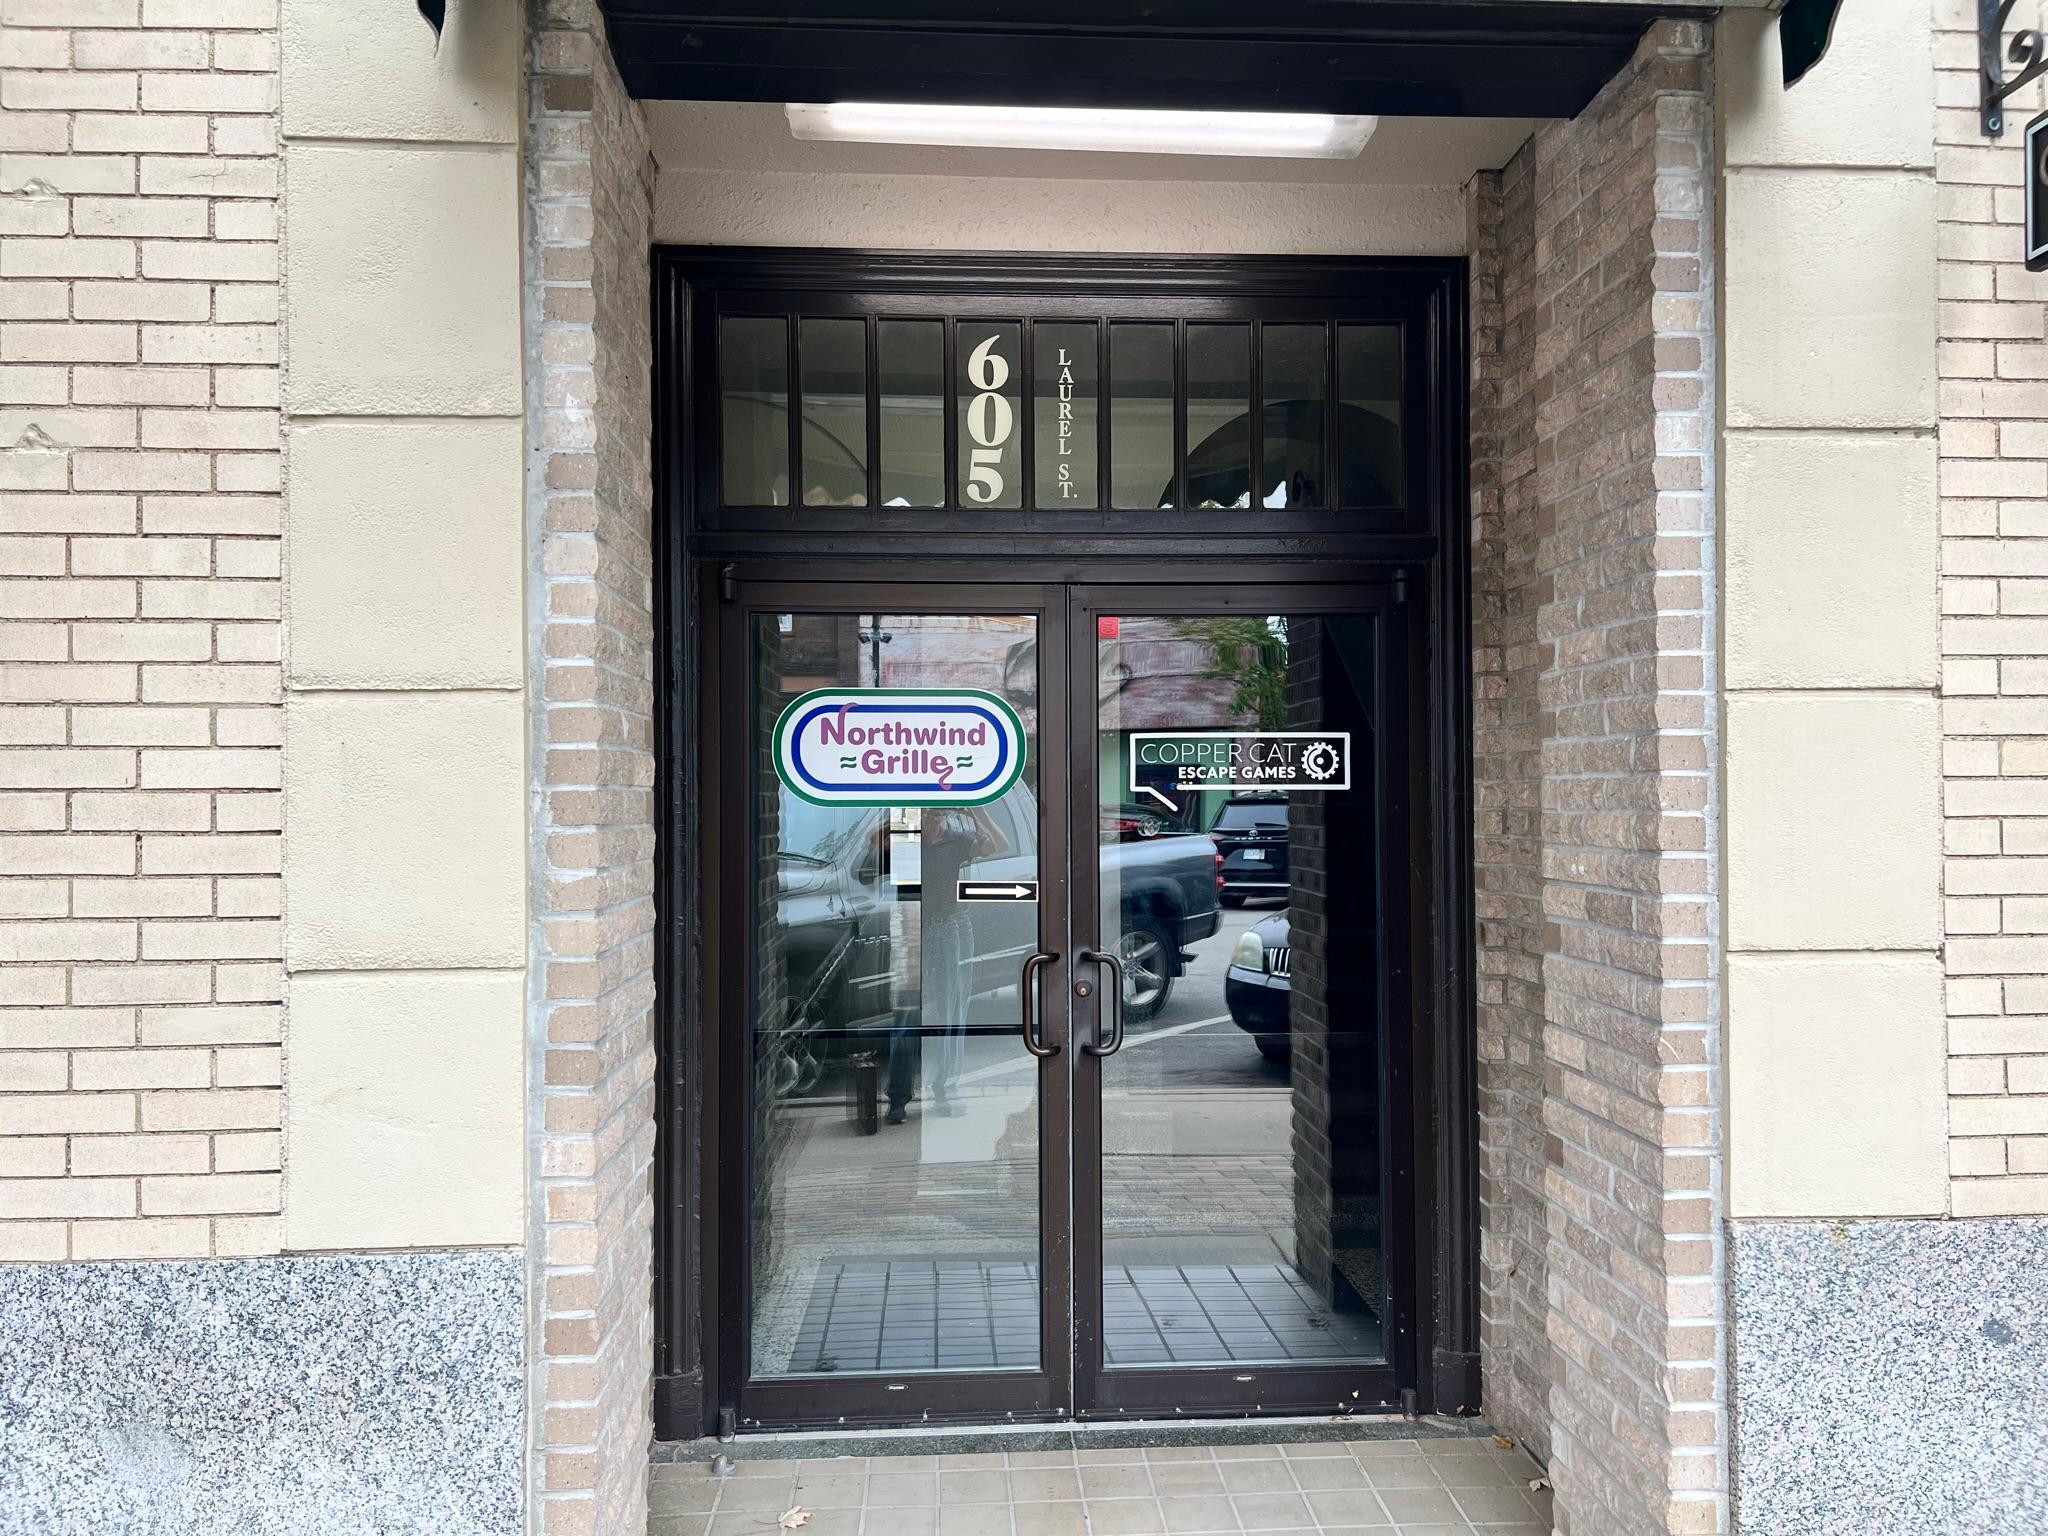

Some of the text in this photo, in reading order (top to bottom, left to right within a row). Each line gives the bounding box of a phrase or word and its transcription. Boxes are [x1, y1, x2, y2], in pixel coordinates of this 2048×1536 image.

[966, 334, 1013, 503] 605
[1058, 348, 1078, 498] LAUREL ST.
[820, 702, 985, 746] Northwind
[861, 749, 954, 791] Grille
[1140, 743, 1297, 764] COPPER CAT
[1178, 766, 1296, 779] ESCAPE GAMES
